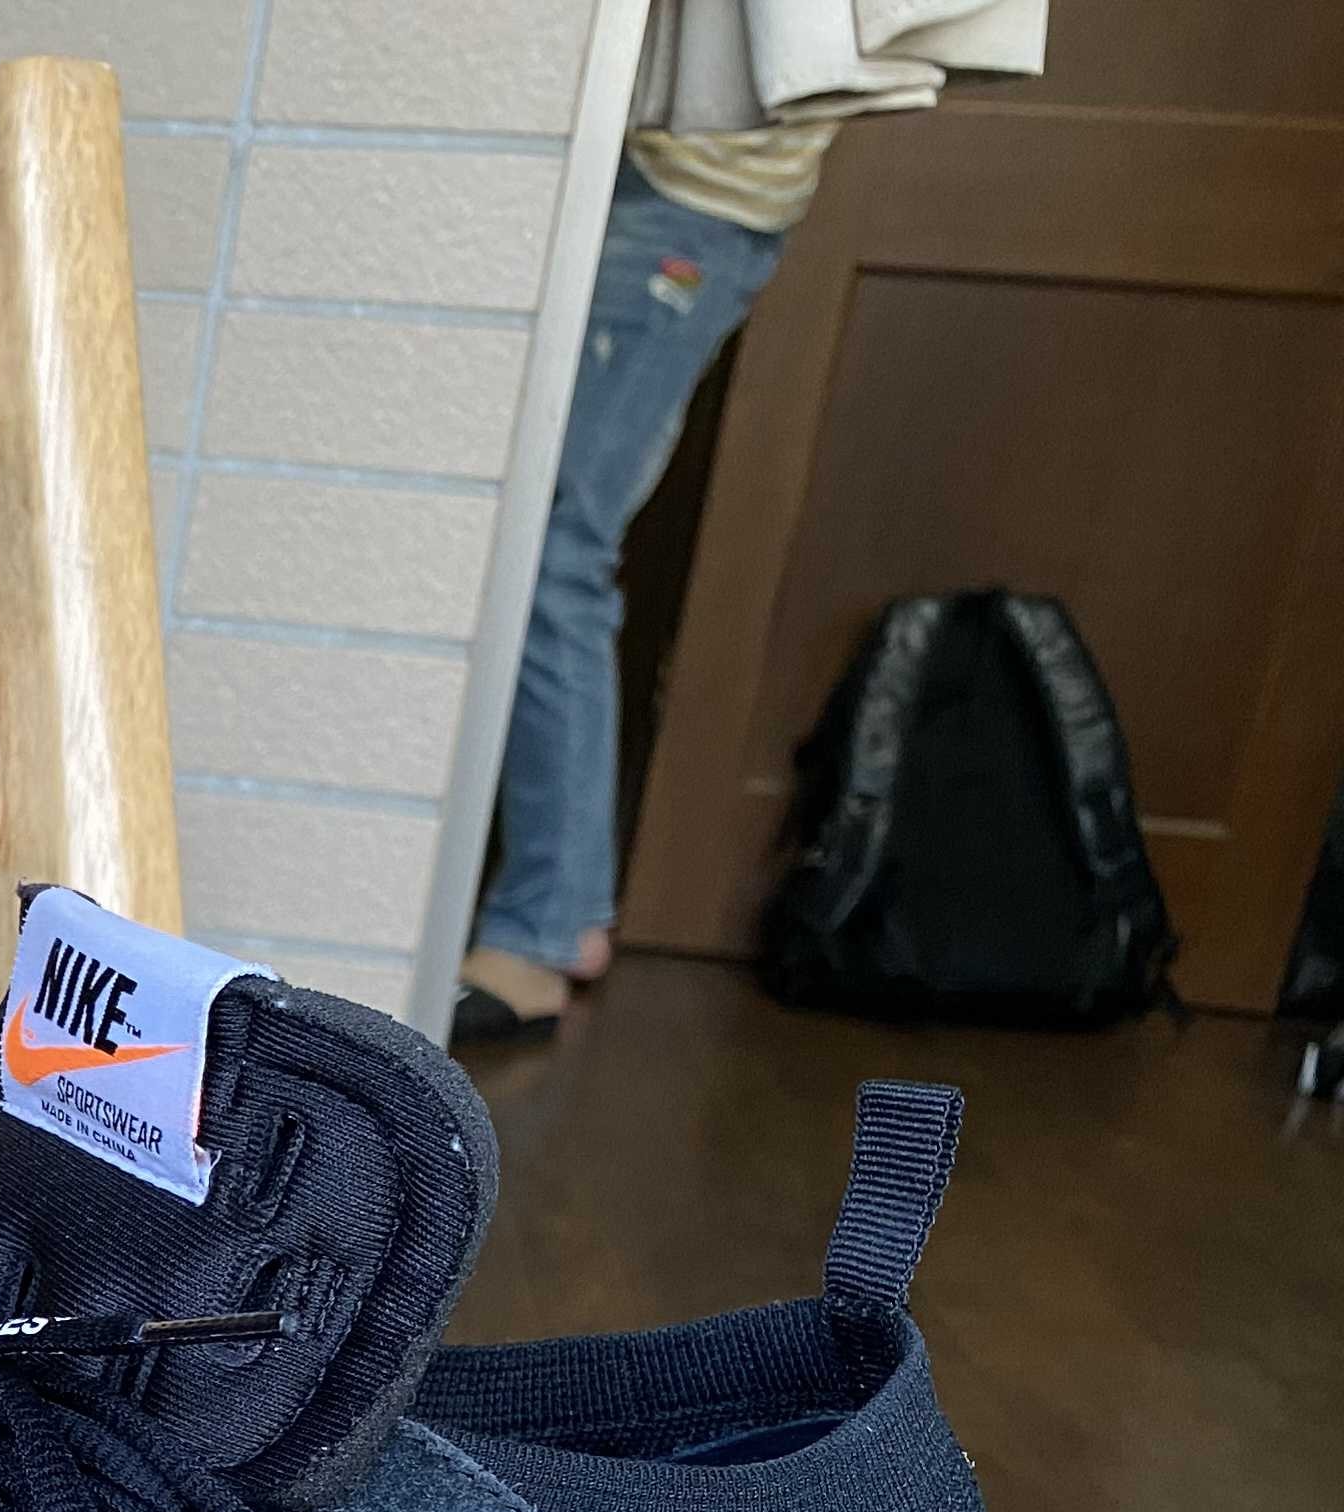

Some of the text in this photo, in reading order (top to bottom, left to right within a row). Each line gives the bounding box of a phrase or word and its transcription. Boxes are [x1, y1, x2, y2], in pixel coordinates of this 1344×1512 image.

[33, 937, 139, 1057] NIKE
[41, 1099, 138, 1163] MADE IN CHINA
[56, 1074, 163, 1155] SPORTSWEAR
